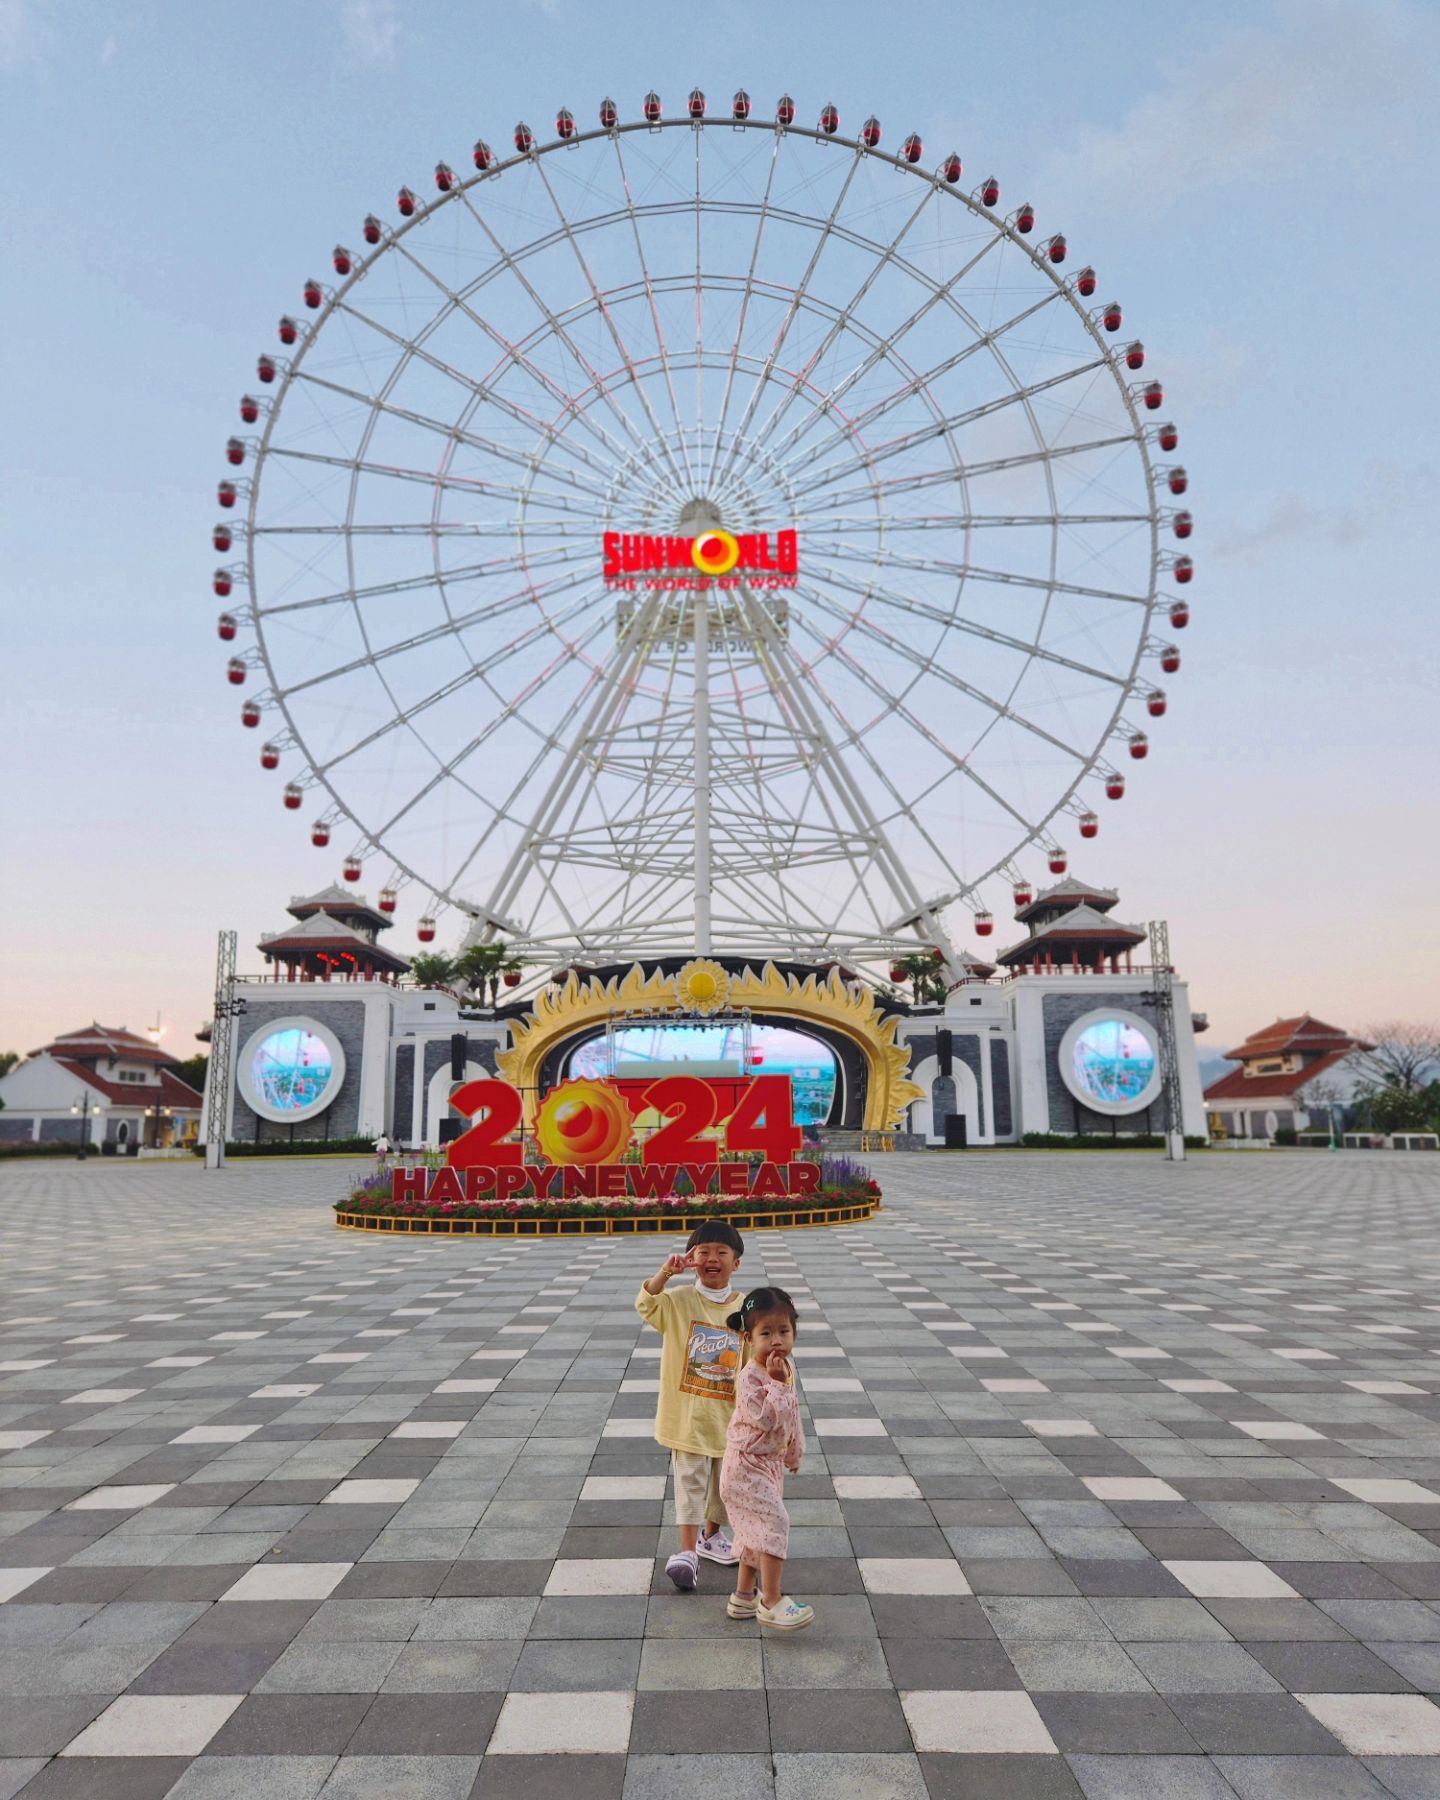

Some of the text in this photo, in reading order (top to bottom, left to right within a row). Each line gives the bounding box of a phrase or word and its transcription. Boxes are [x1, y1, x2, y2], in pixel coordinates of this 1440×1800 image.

[605, 576, 798, 592] THE WORLD OF WOW
[447, 1074, 804, 1166] 2024
[392, 1161, 822, 1201] HAPPY NEW YEAR
